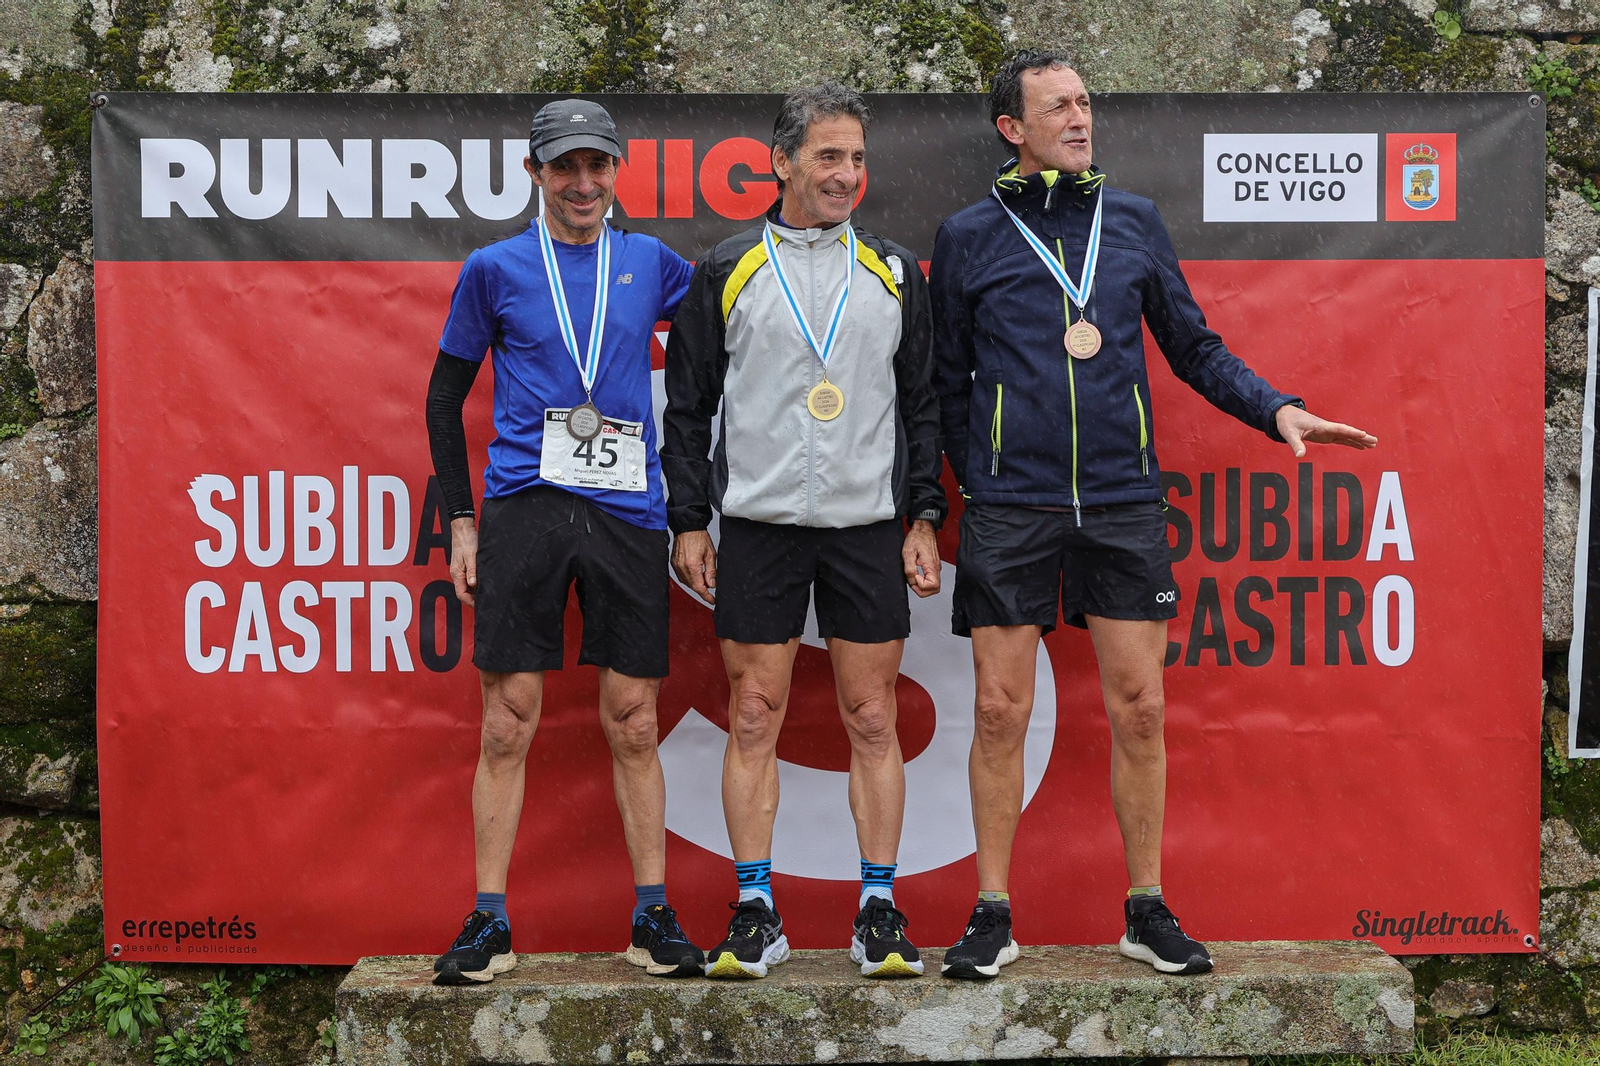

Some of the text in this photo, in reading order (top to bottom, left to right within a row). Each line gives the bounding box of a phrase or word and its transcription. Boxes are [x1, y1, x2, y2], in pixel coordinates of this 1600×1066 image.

[1216, 152, 1364, 175] CONCELLO
[1234, 180, 1347, 202] DE VIGO
[573, 438, 618, 468] 45
[187, 465, 451, 568] SUBIDA
[184, 580, 463, 674] CASTRO
[122, 915, 257, 944] errepetrés
[1477, 936, 1519, 944] sports
[123, 943, 258, 954] deseño e publicidade
